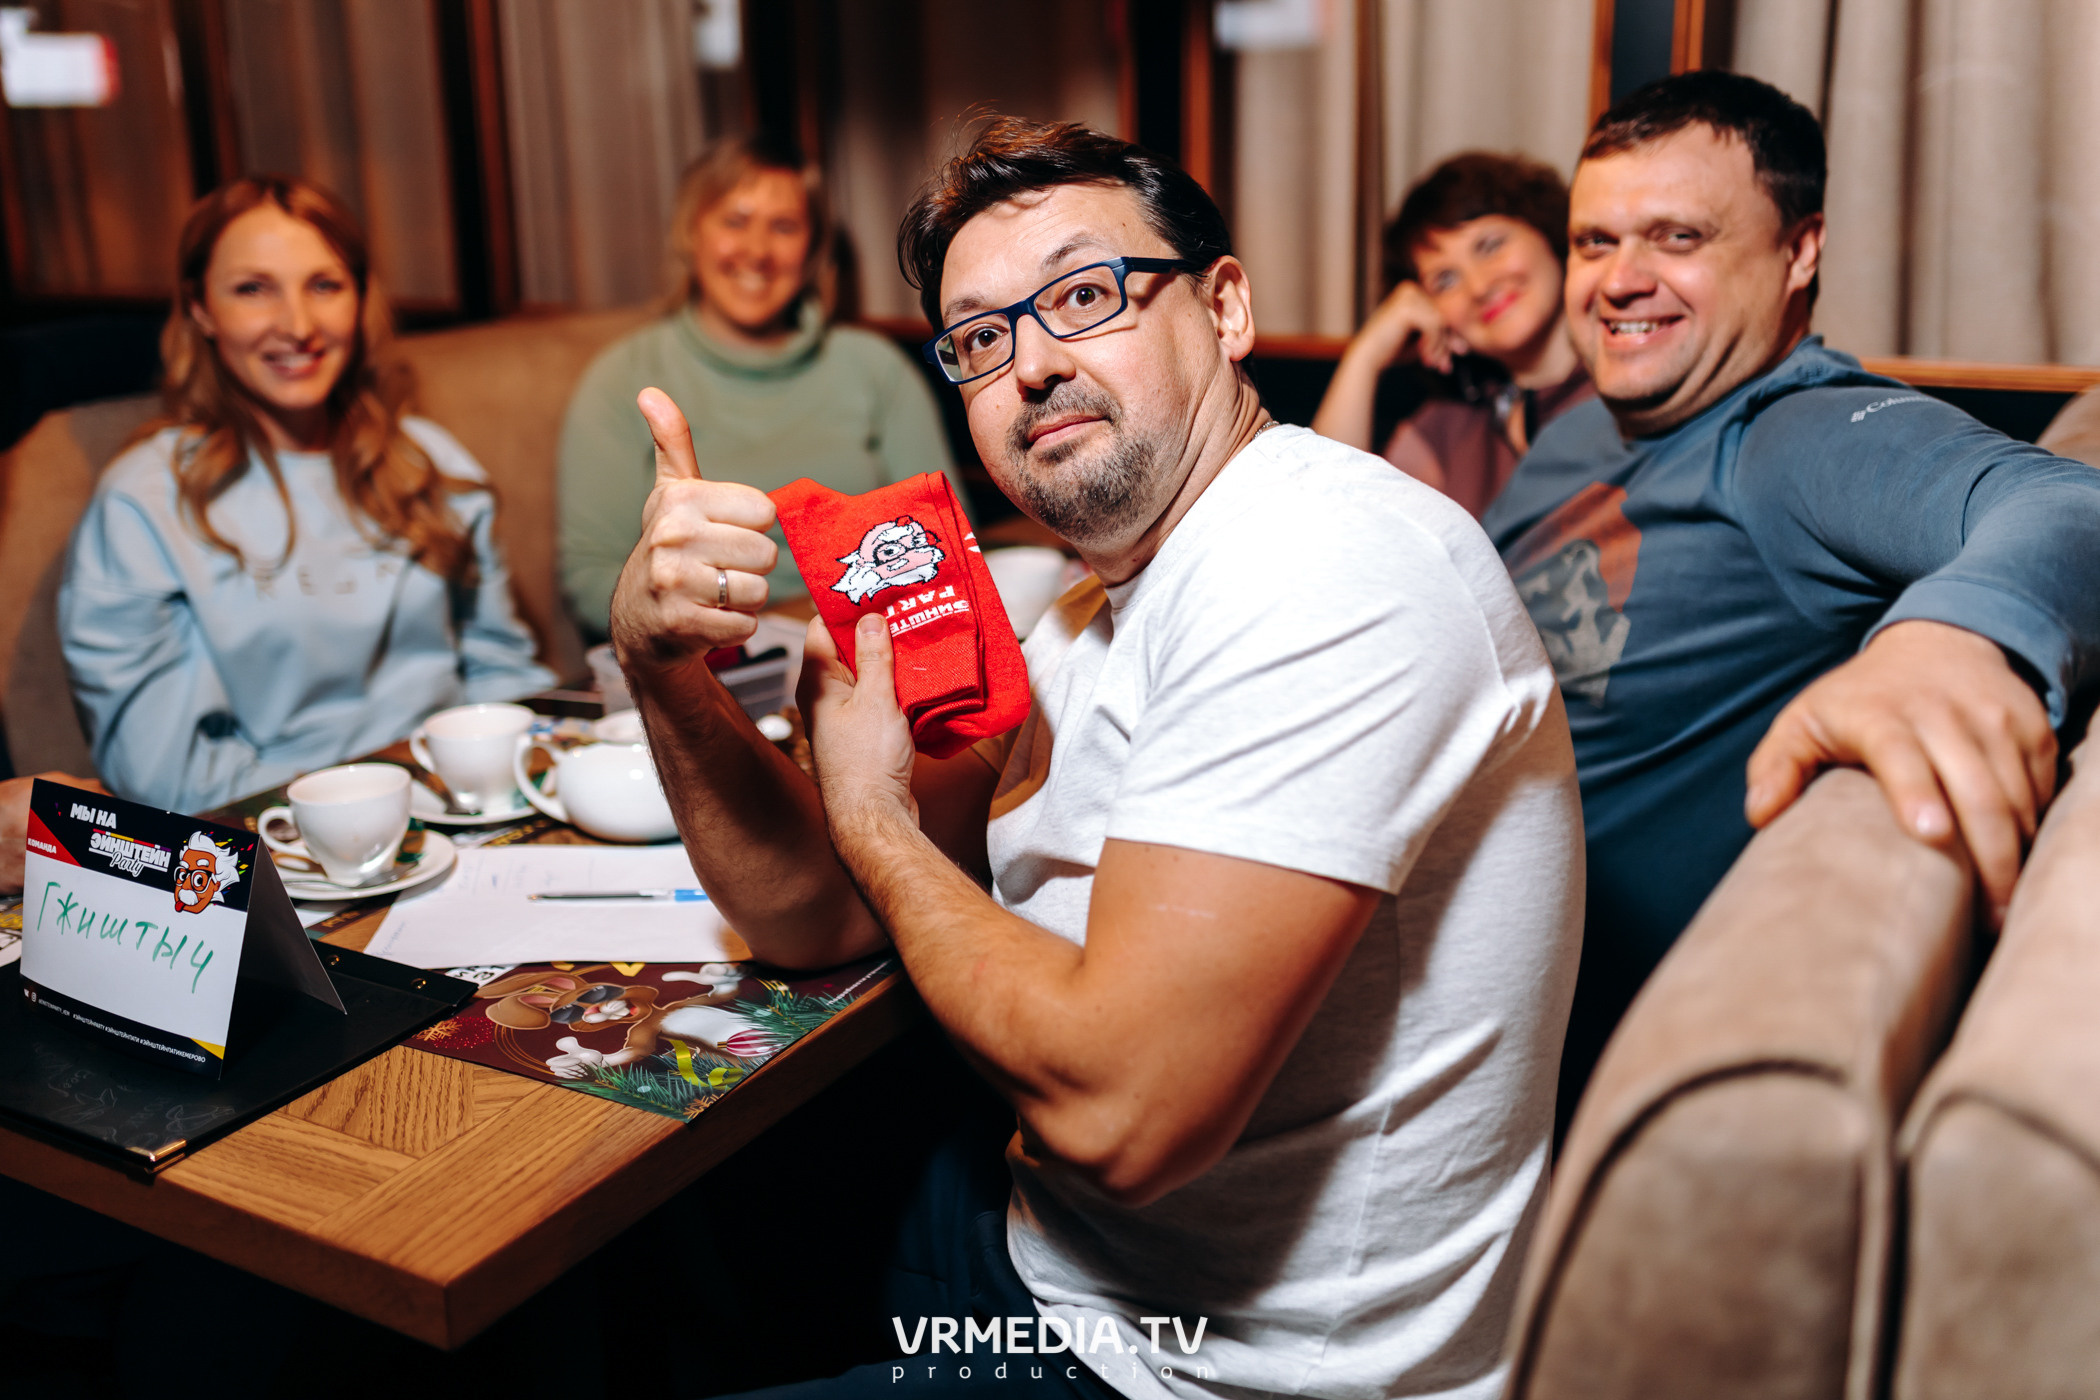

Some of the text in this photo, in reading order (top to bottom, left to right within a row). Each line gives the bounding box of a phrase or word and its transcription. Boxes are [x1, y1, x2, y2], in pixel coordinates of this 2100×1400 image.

[886, 585, 955, 619] PART
[70, 803, 117, 829] МЫ НА
[27, 838, 57, 854] КОМАНДА
[90, 831, 171, 868] ЭЙНШТЕЙН
[109, 851, 145, 877] Party
